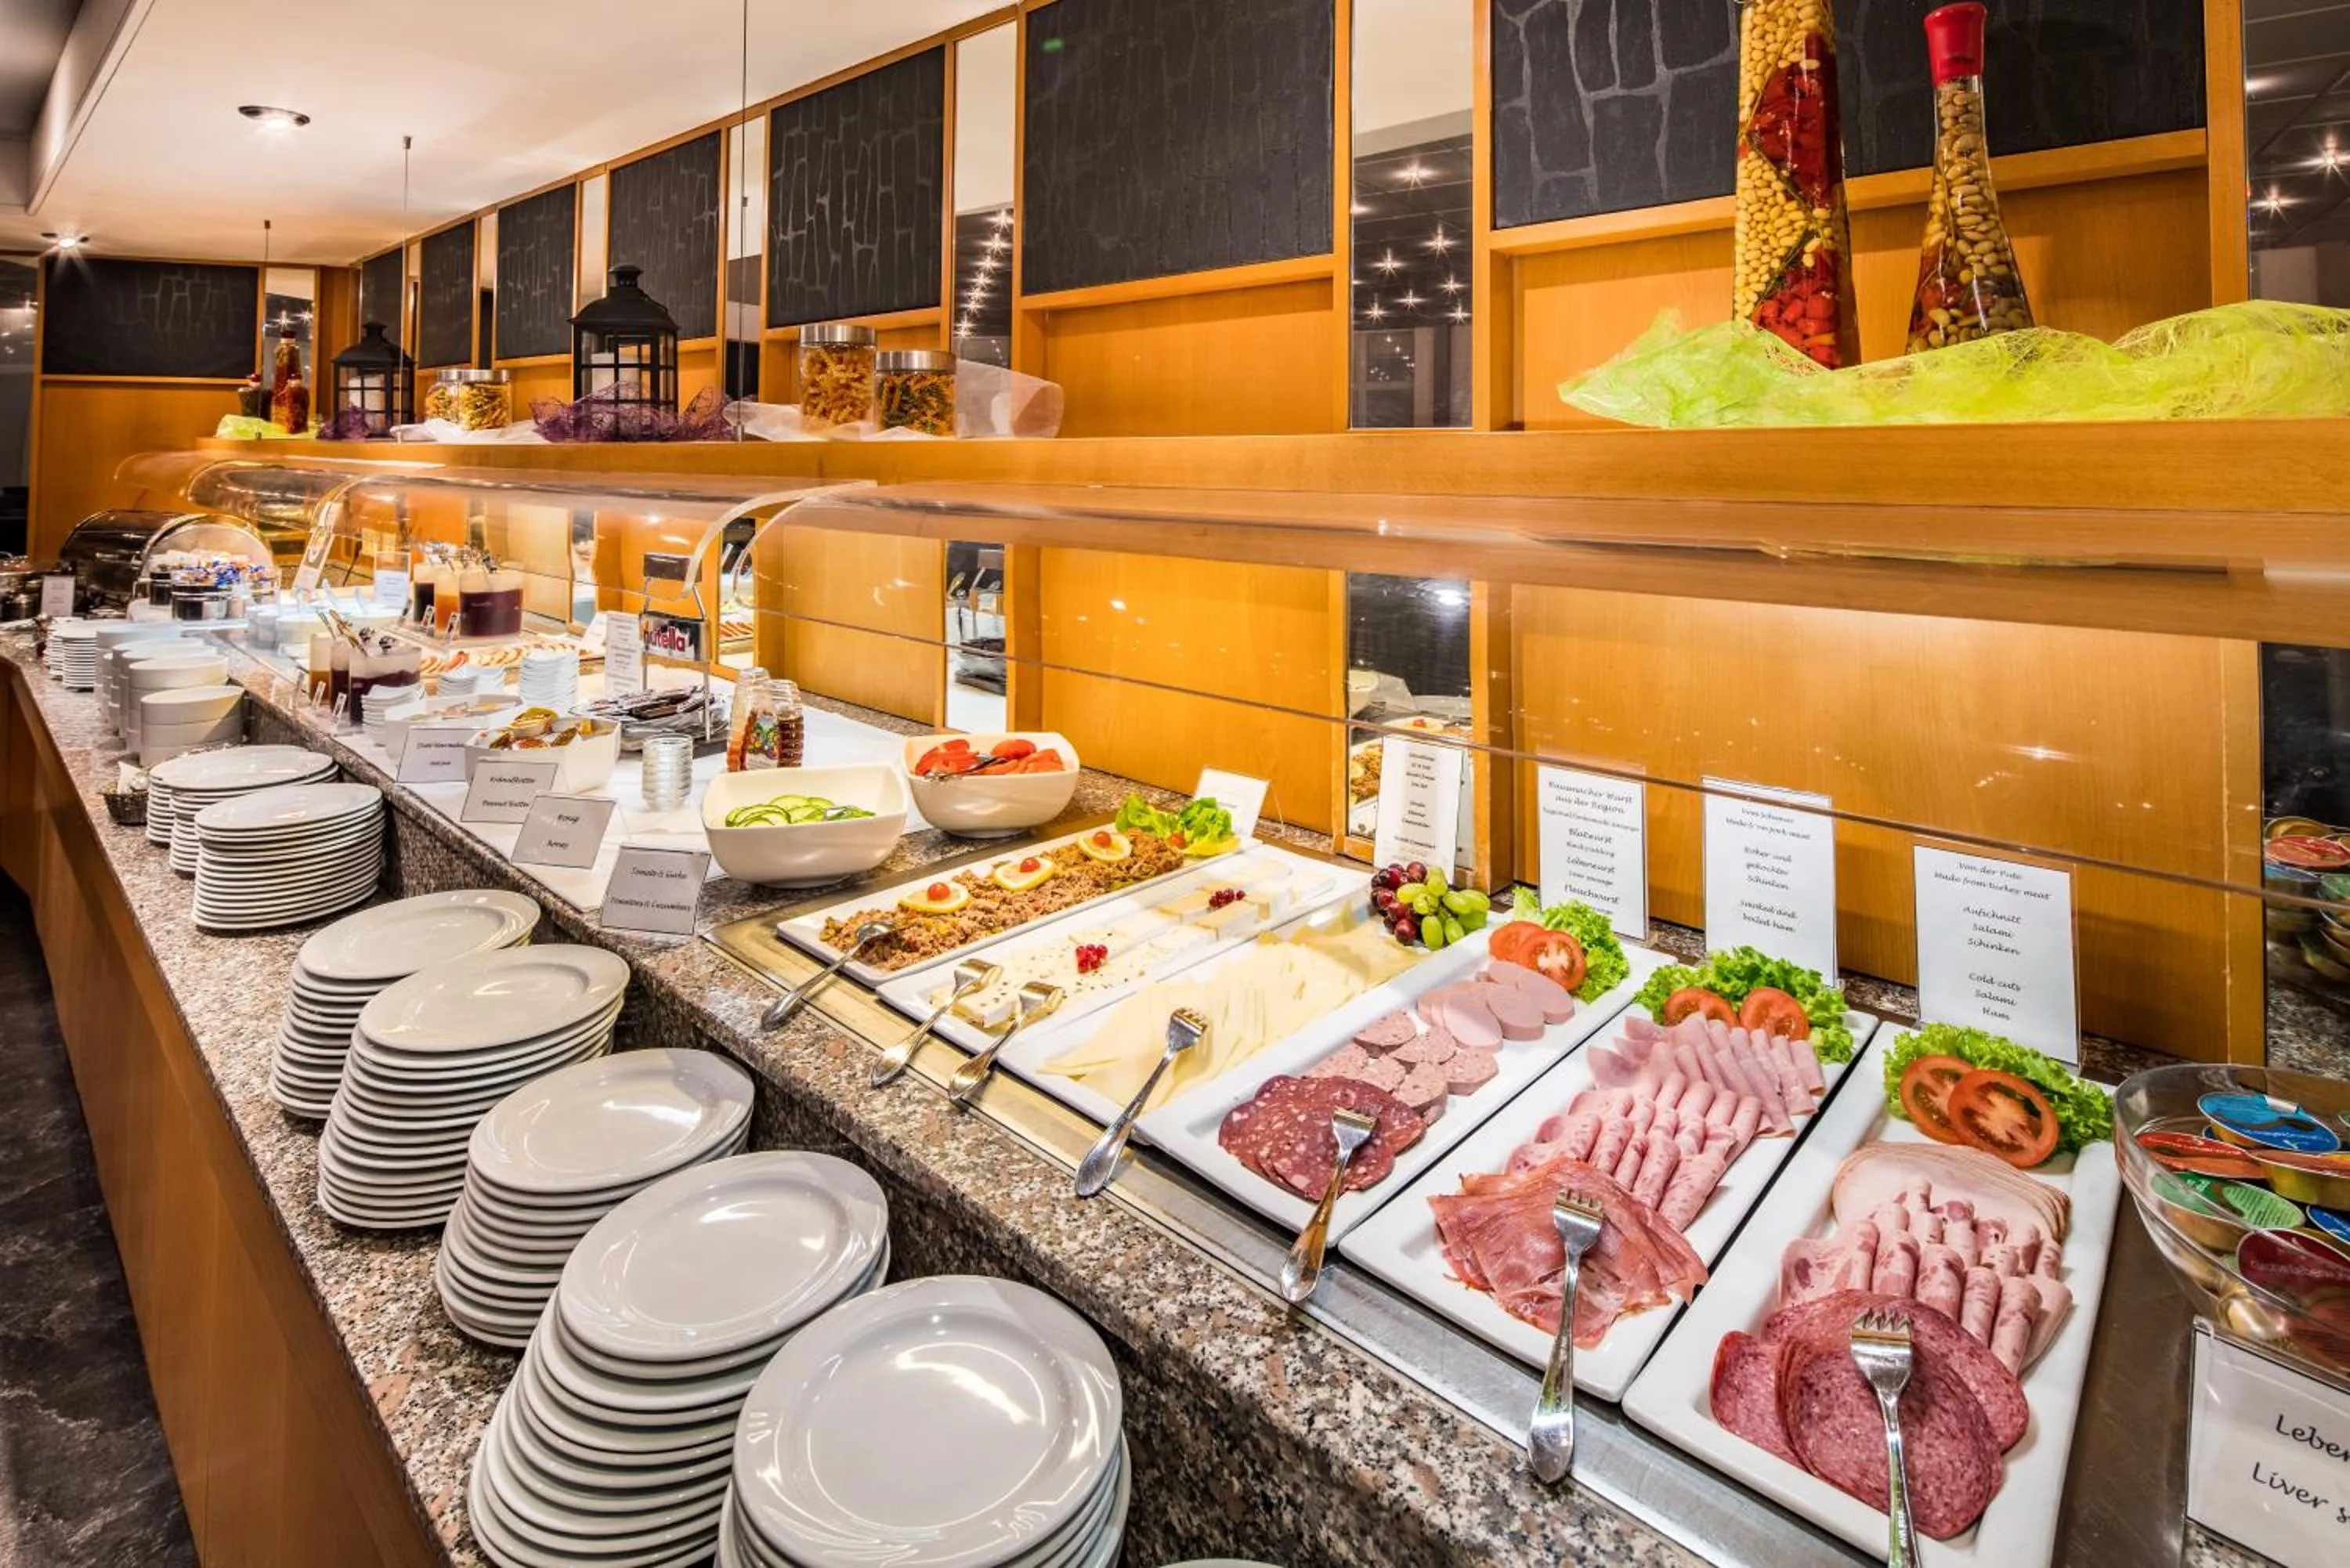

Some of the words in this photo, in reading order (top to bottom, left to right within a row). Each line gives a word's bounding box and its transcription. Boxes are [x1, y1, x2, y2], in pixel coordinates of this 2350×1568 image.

[643, 626, 685, 652] nutella
[1962, 876, 1987, 888] from
[1989, 882, 2022, 896] turkey
[2023, 890, 2052, 900] meat
[1961, 905, 2023, 925] Aufschnitt
[1972, 923, 2016, 938] Salami
[1968, 938, 2021, 955] Schinken
[1968, 972, 1997, 985] Cold
[1998, 981, 2022, 992] cuts
[1975, 989, 2017, 1006] Salami
[2252, 1461, 2330, 1508] Liver
